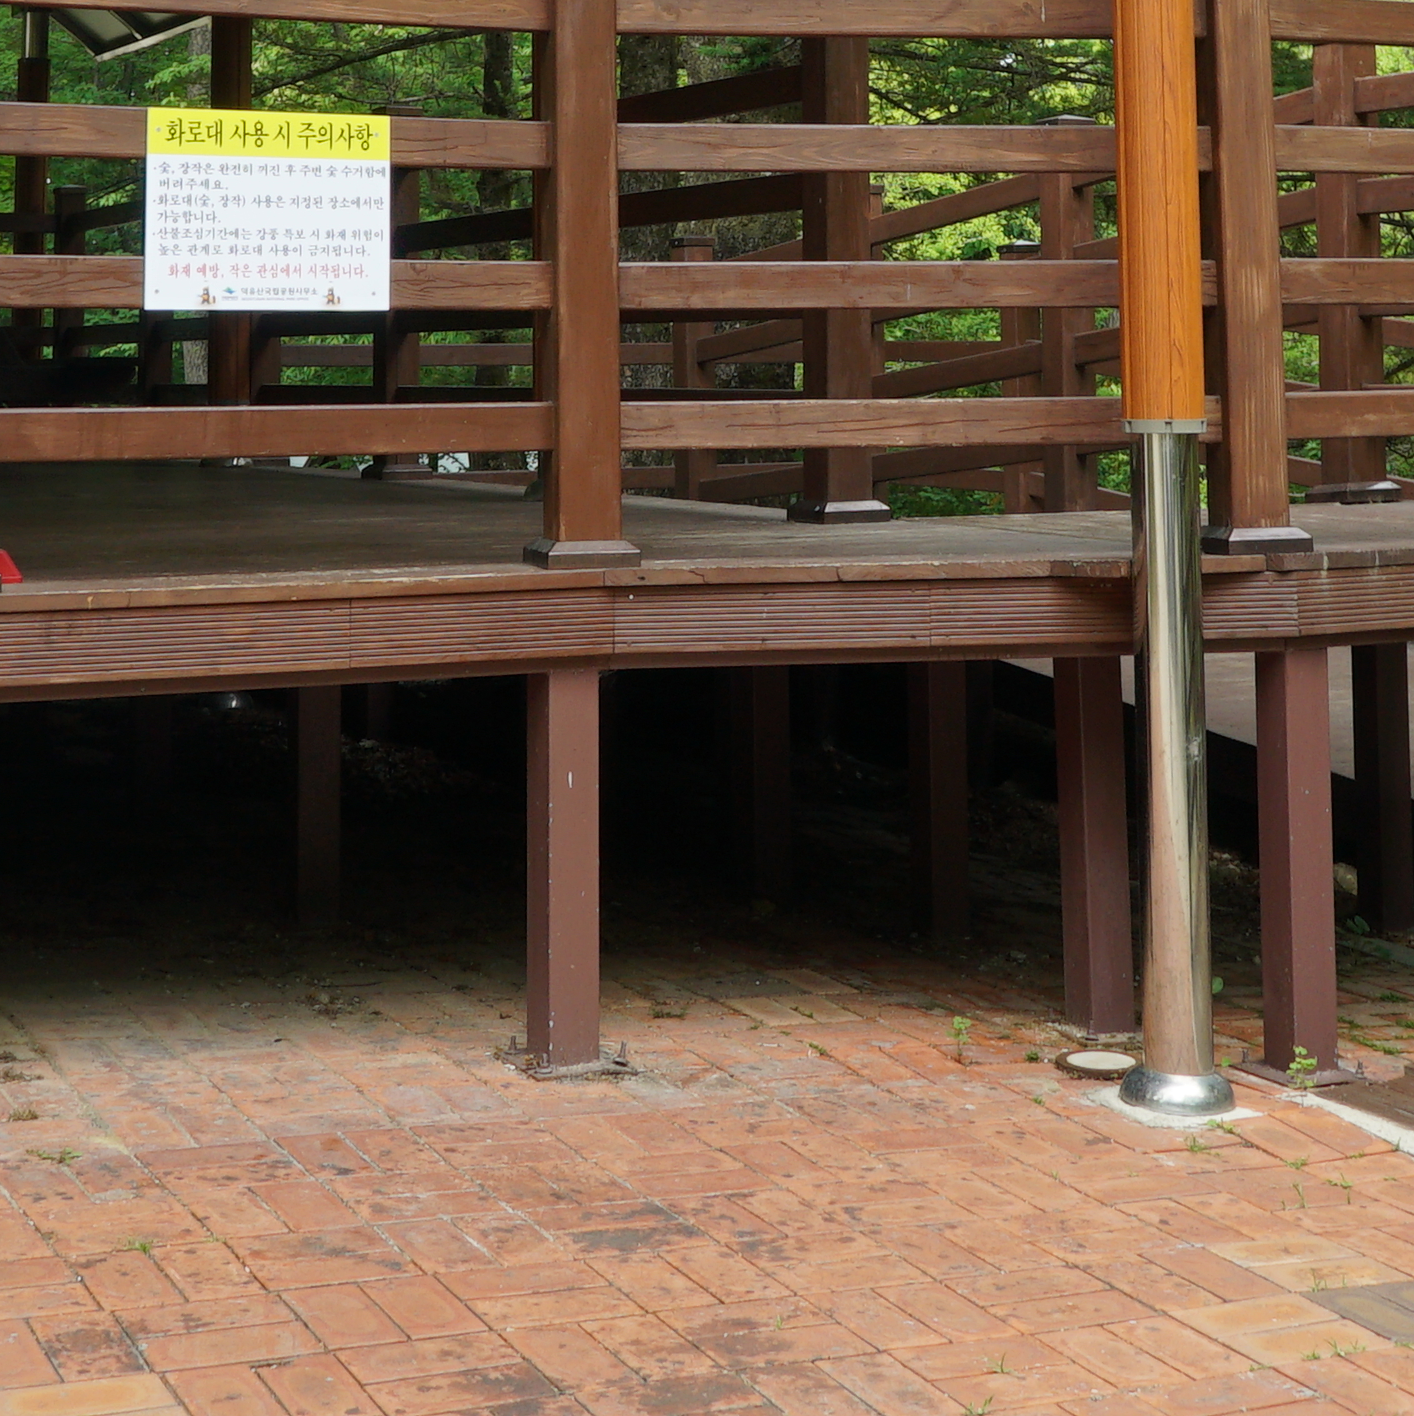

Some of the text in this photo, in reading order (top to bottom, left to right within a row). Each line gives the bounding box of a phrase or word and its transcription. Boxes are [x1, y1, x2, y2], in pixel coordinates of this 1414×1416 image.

[165, 118, 373, 151] 화로대 사용 시 주의사항
[179, 162, 215, 176] 장작은
[218, 163, 253, 176] 완전히
[251, 196, 286, 209] 사용은
[289, 196, 323, 210] 지정된
[327, 196, 384, 210] 장소에서만
[156, 210, 221, 224] 가능합니다.
[156, 227, 384, 242] 산불조심기간에는 강풍 특보 시 화재 위험이
[158, 243, 371, 258] 높은 관계로 화로대 사용이 금지됩니다.
[168, 263, 369, 279] 화재 예방, 작은 관심에서 시작됩니다.
